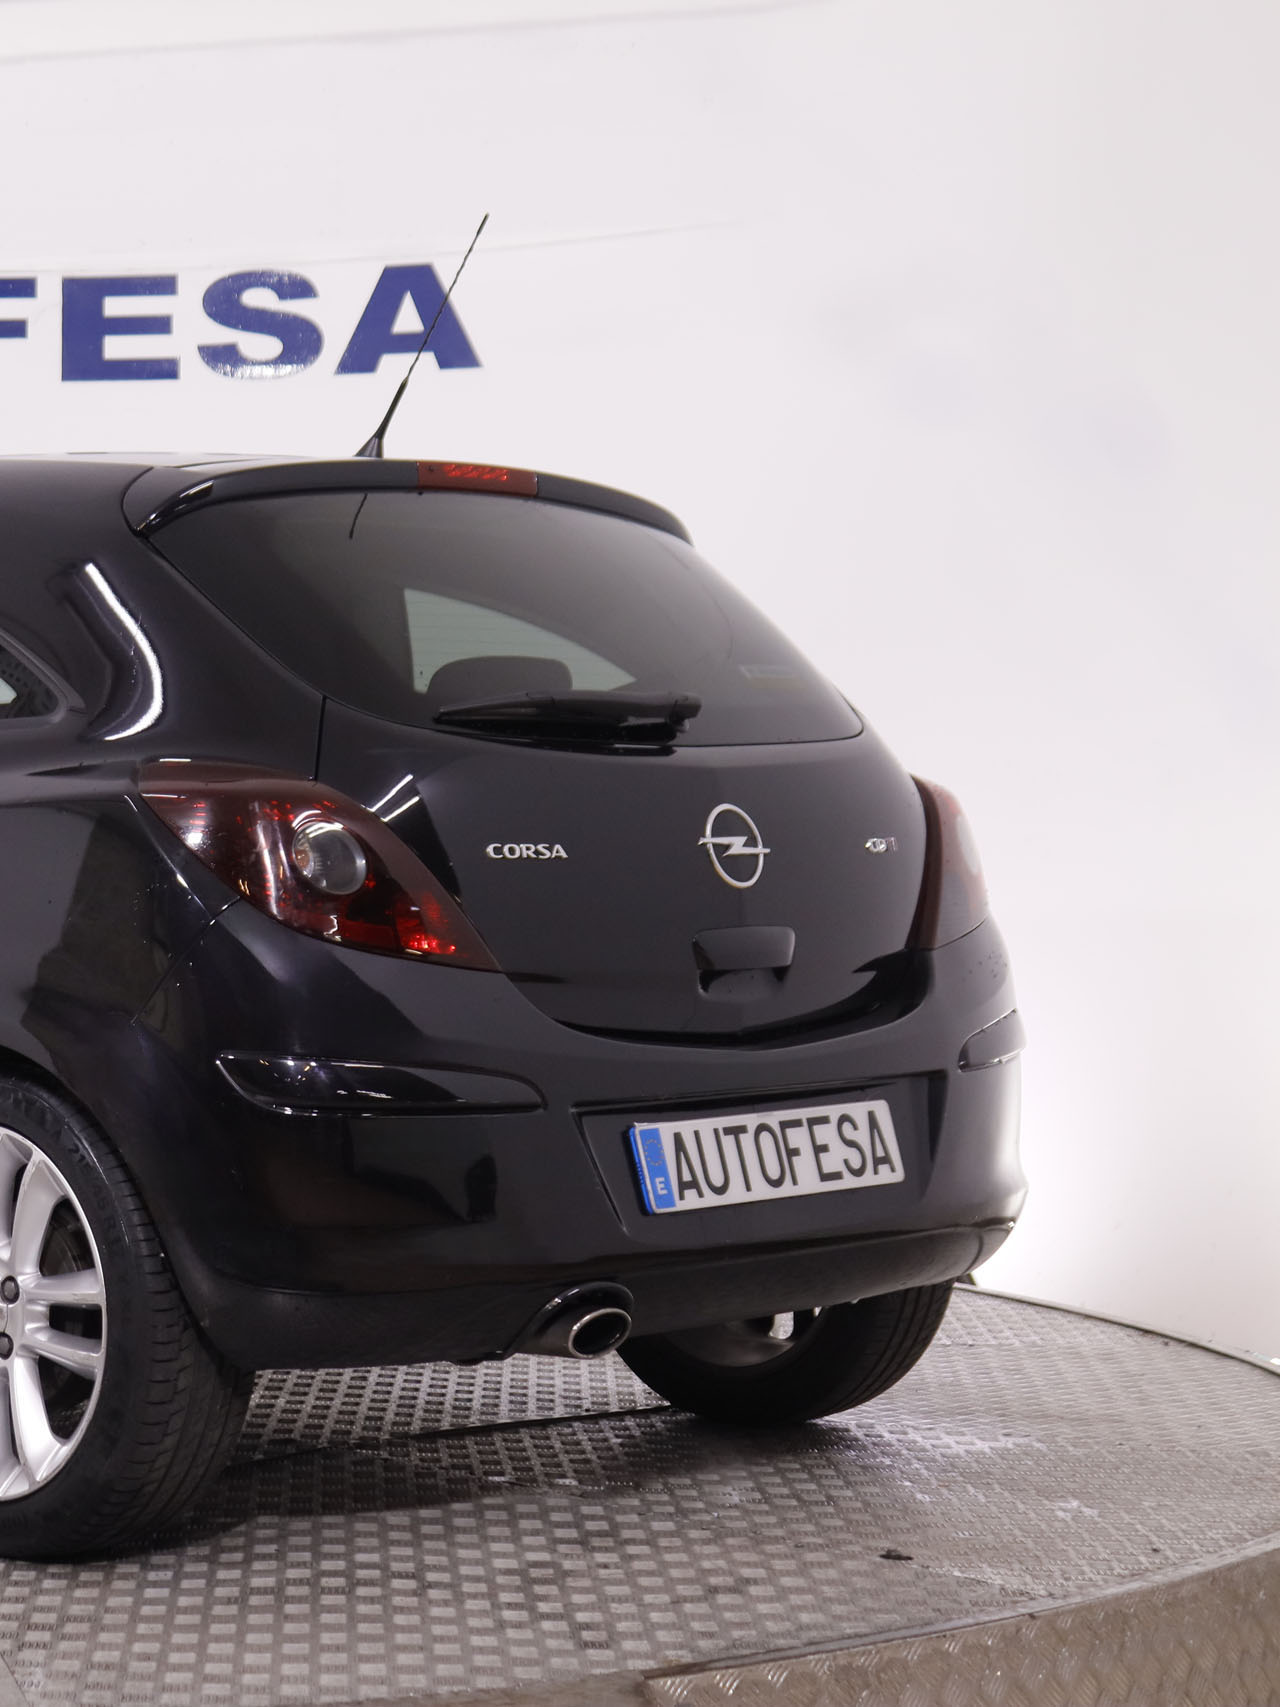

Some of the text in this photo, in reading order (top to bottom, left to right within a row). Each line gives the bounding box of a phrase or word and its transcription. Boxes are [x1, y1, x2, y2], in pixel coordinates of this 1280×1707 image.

[485, 843, 569, 859] CORSA
[673, 1109, 897, 1201] AUTOFESA
[655, 1177, 668, 1196] E
